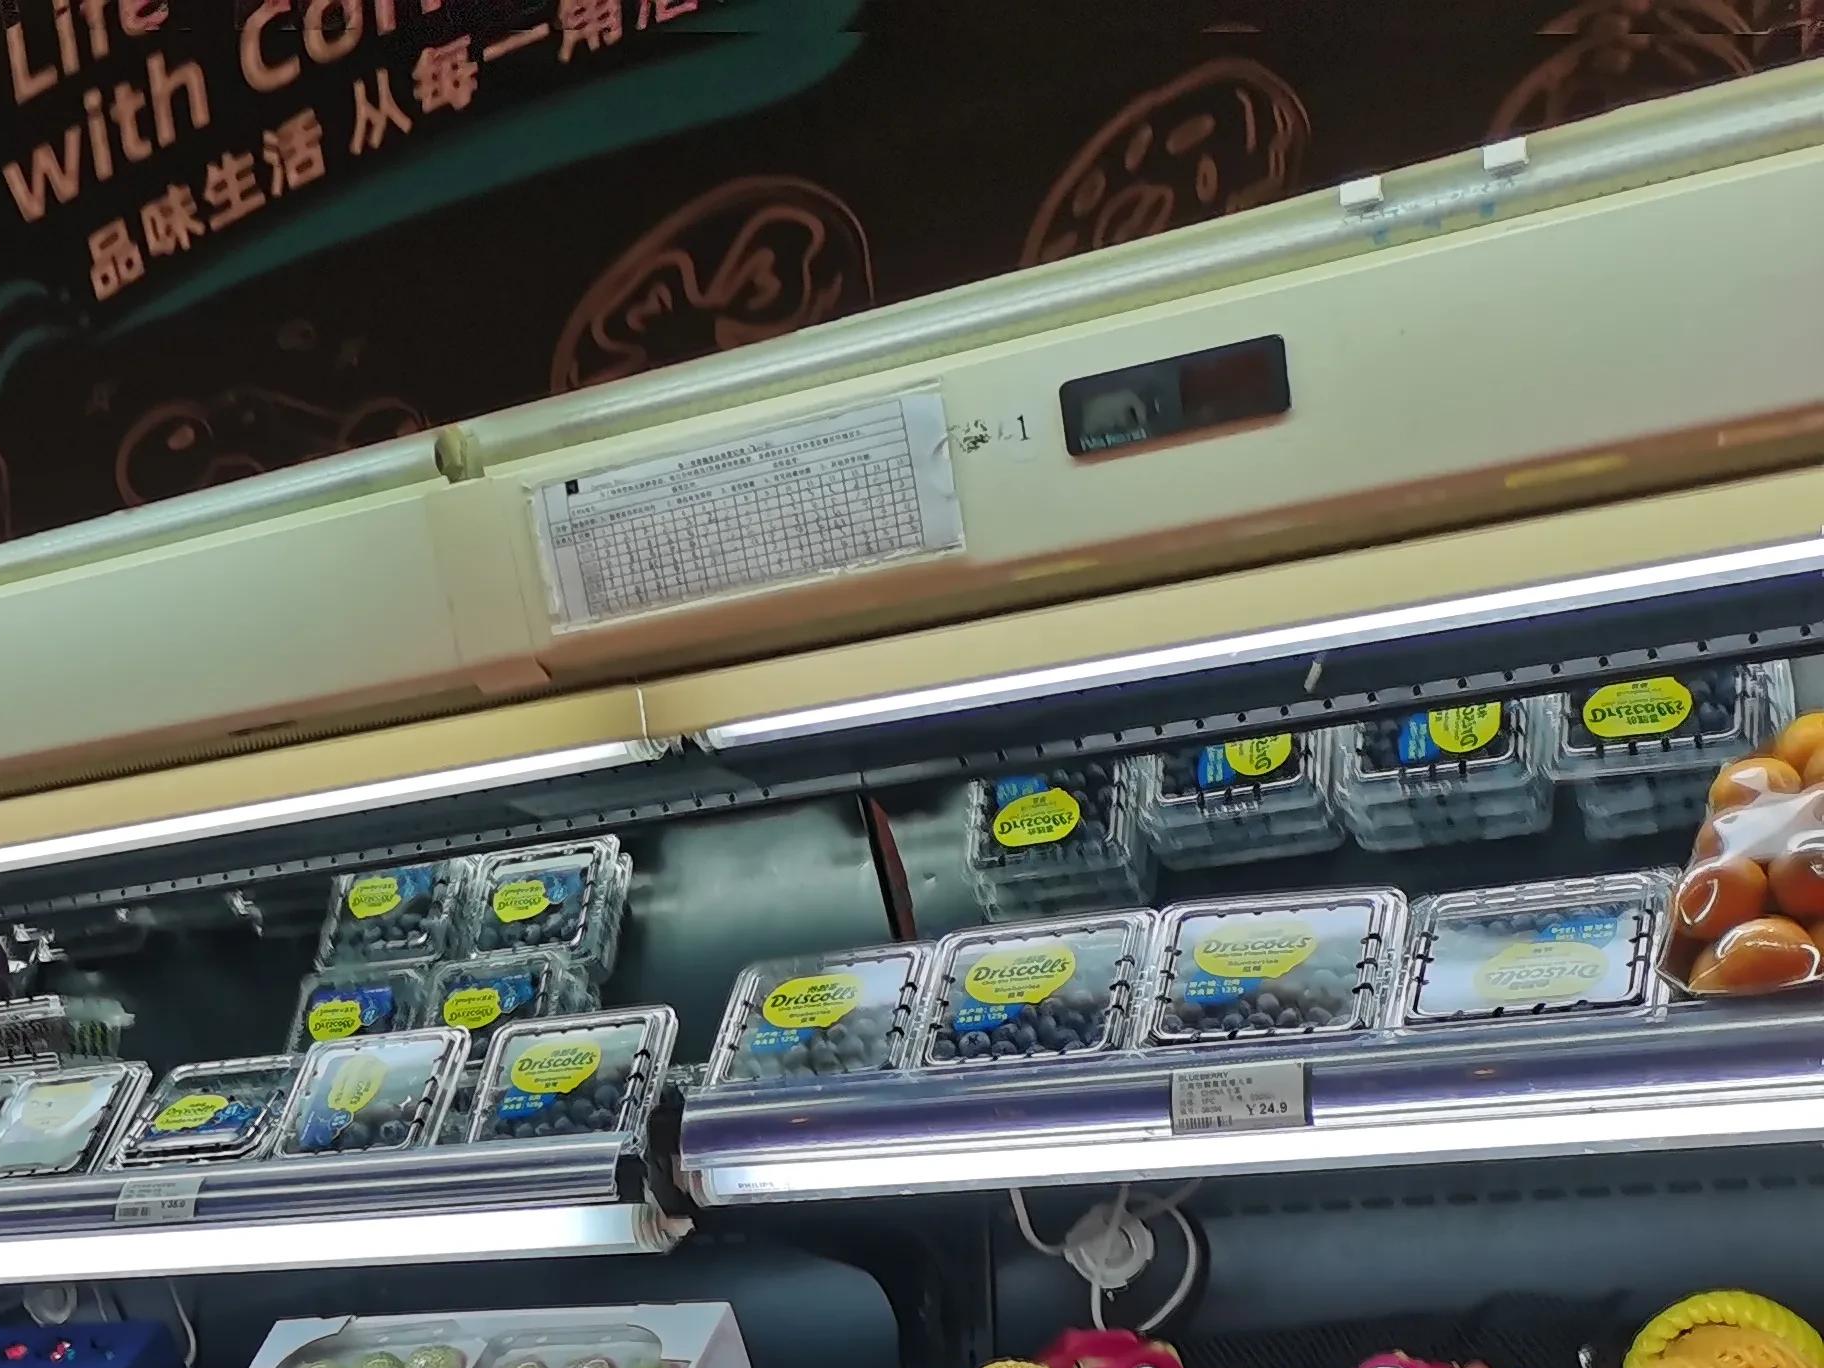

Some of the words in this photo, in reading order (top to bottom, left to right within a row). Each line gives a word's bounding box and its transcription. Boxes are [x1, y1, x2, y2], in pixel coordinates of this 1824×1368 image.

[87, 107, 326, 300] 品味生活
[1203, 936, 1313, 954] Driscoll's
[973, 957, 1070, 982] Driscoll's
[770, 986, 858, 1008] Driscoll's
[517, 1052, 598, 1072] Driscoll's
